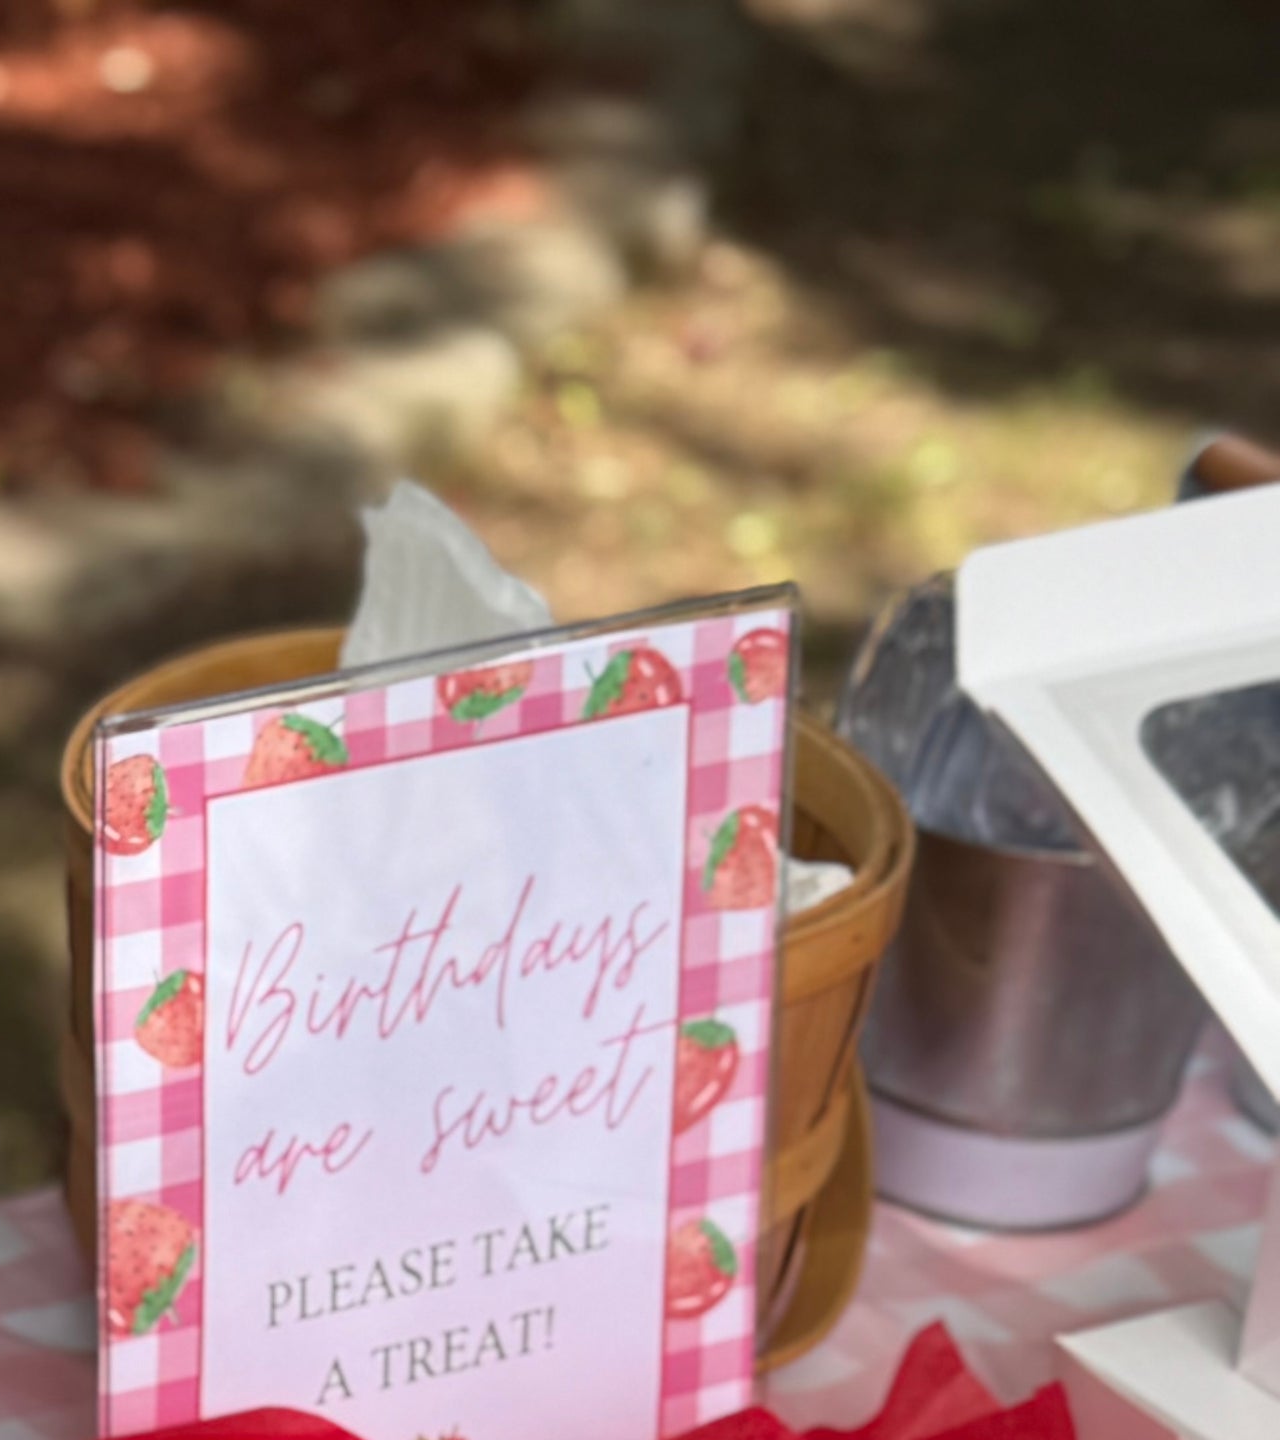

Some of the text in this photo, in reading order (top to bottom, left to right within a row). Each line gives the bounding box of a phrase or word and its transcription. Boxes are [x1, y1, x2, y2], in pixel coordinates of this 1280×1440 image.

[226, 873, 671, 1076] Birthdays
[233, 1003, 677, 1196] are sweet
[266, 1204, 612, 1331] PLEASE TAKE
[315, 1305, 556, 1406] A TREAT!
